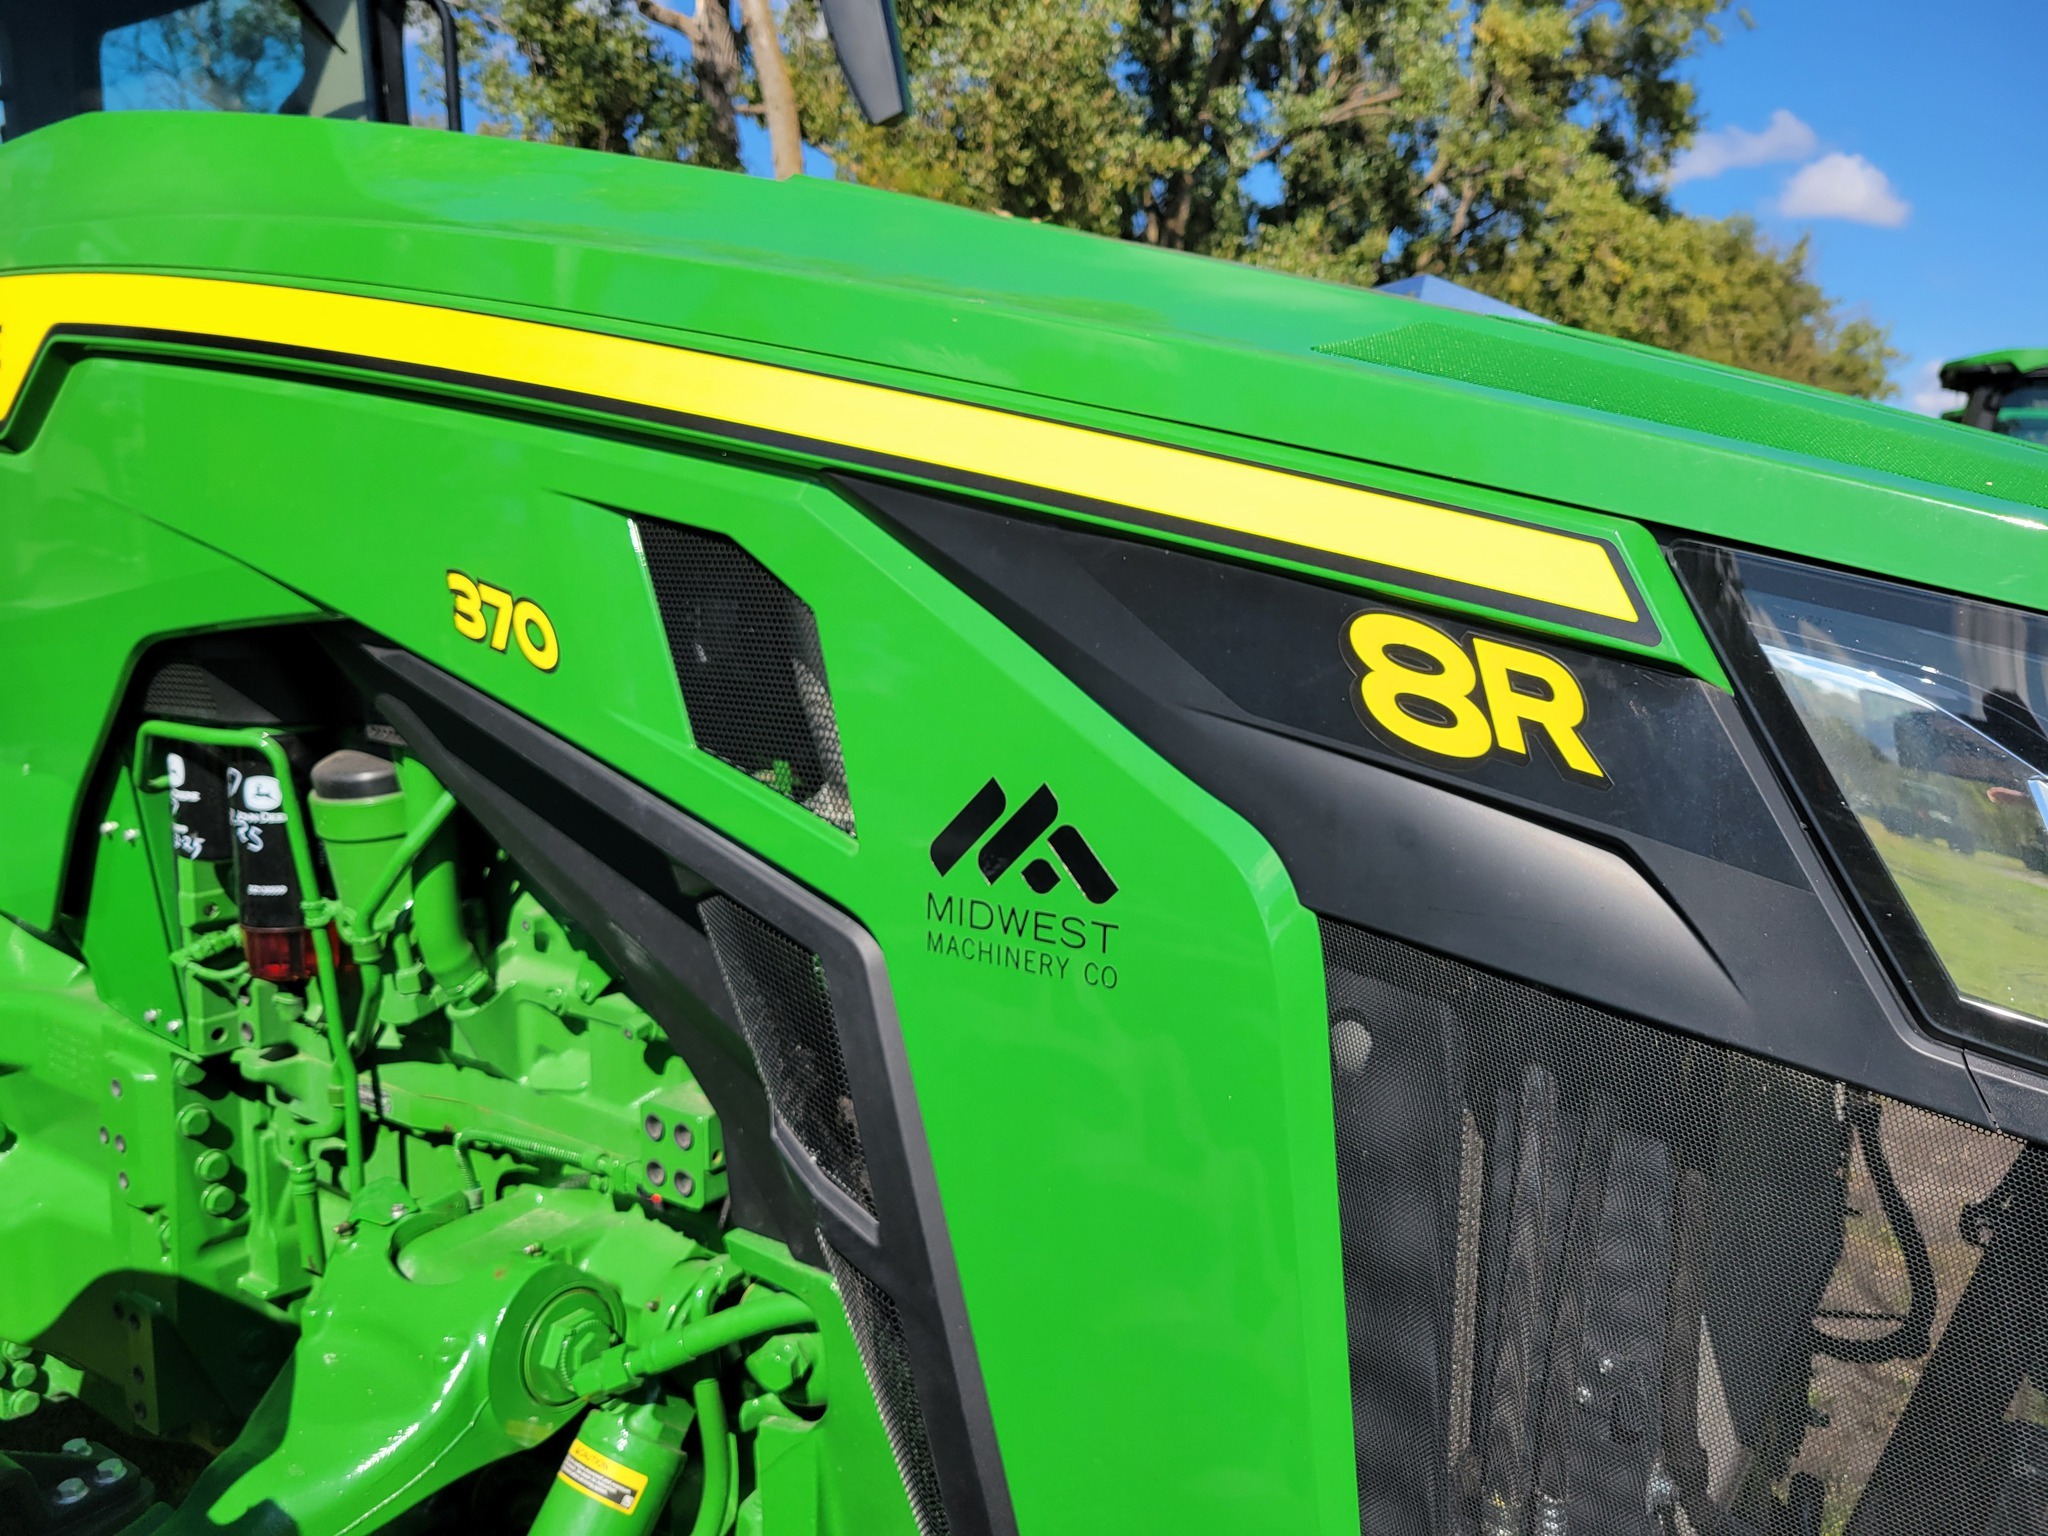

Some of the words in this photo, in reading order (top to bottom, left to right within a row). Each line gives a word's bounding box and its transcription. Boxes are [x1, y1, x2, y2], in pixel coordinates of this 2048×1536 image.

[446, 569, 560, 673] 370
[1348, 612, 1605, 778] 8R
[926, 930, 1069, 979] MACHINERY
[1084, 961, 1118, 989] CO
[927, 891, 1119, 954] MIDWEST
